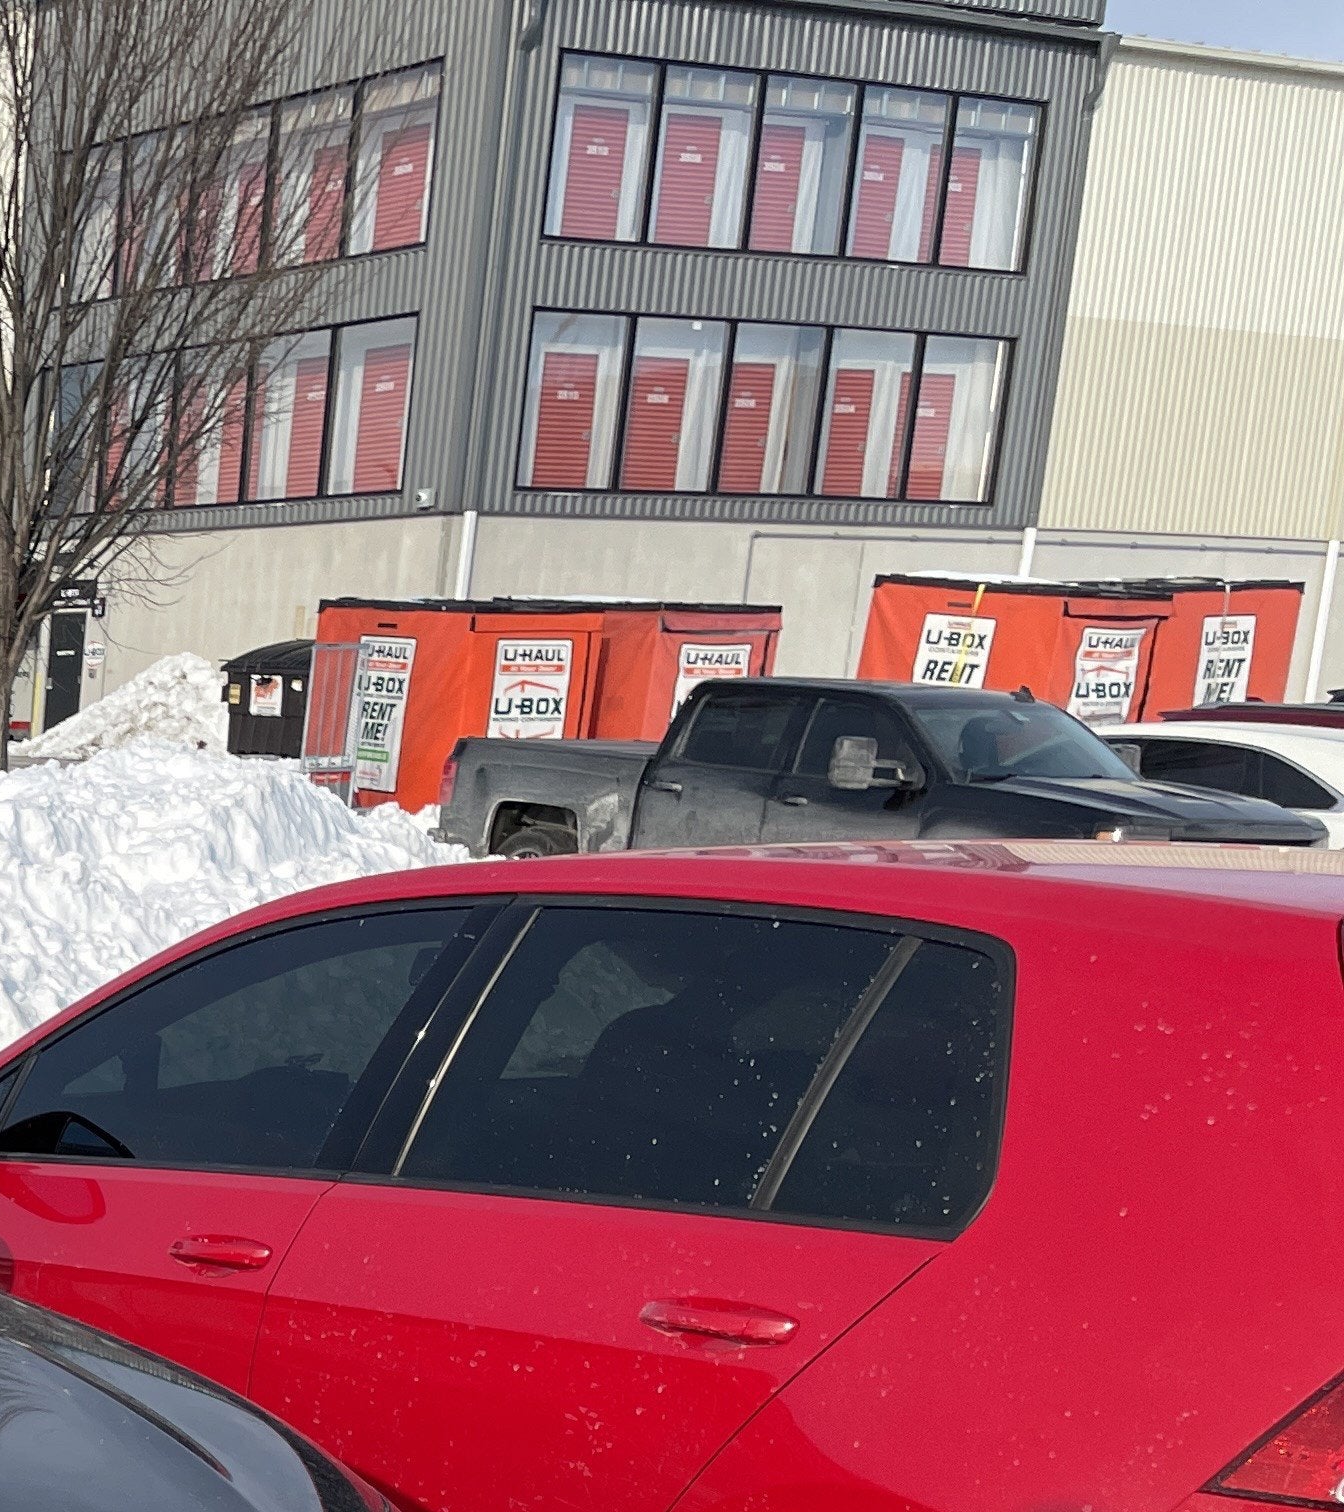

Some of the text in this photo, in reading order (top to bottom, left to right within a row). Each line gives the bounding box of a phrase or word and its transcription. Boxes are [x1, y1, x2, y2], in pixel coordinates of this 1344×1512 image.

[925, 629, 988, 651] U-BOX
[1204, 629, 1251, 647] U-BOX
[504, 648, 564, 663] U-HAUL
[686, 652, 742, 666] U-HAUL
[357, 674, 406, 695] U-BOX
[1075, 681, 1133, 699] U-BOX
[362, 701, 397, 722] RENT
[493, 697, 563, 716] U-BOX
[361, 721, 389, 742] ME!
